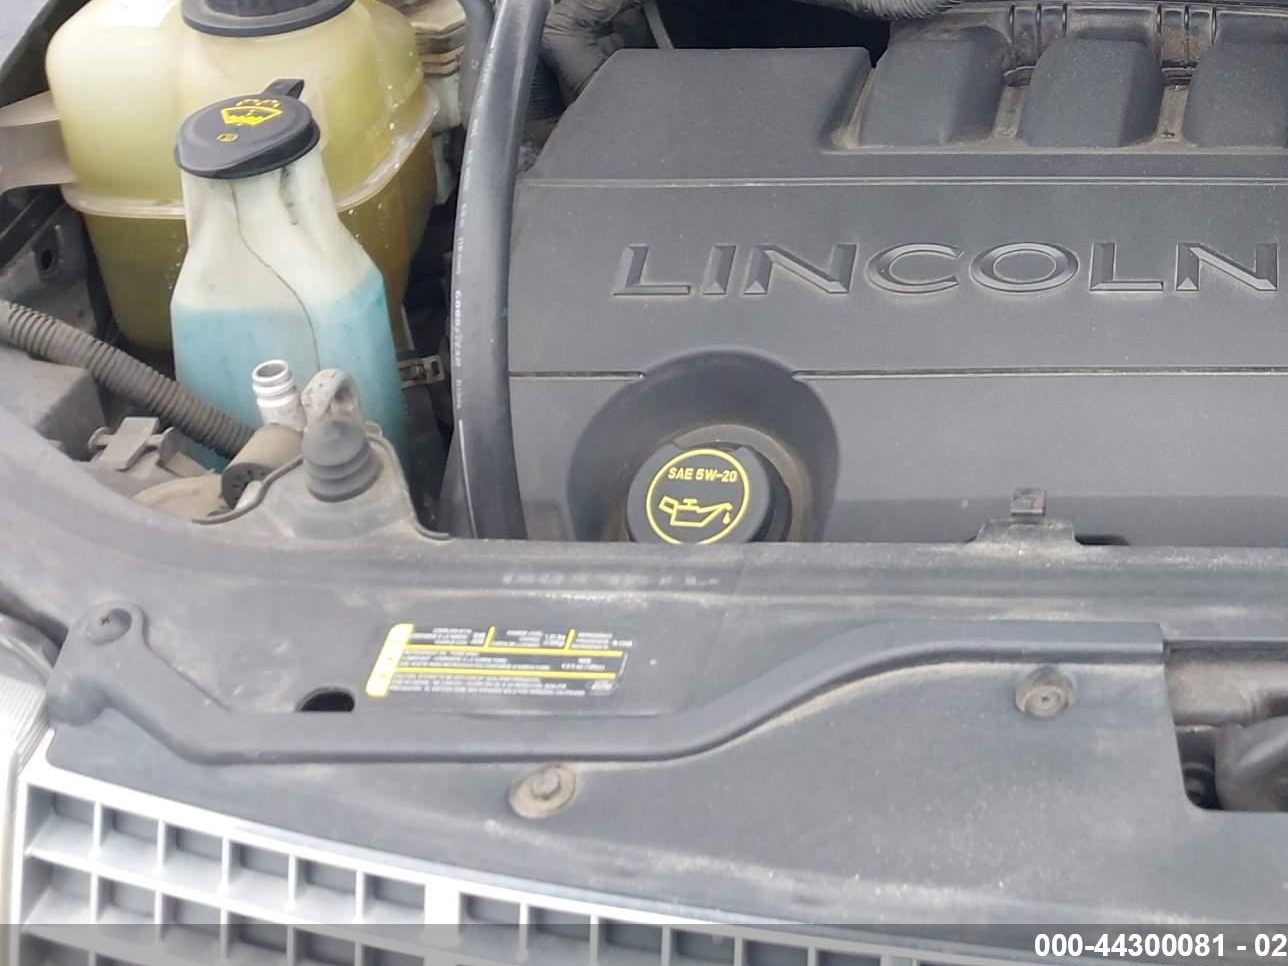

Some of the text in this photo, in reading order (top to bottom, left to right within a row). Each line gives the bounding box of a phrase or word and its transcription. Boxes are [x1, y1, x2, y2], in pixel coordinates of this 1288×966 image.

[612, 241, 1278, 296] LINCOLN
[668, 467, 738, 482] SAE 5W-20
